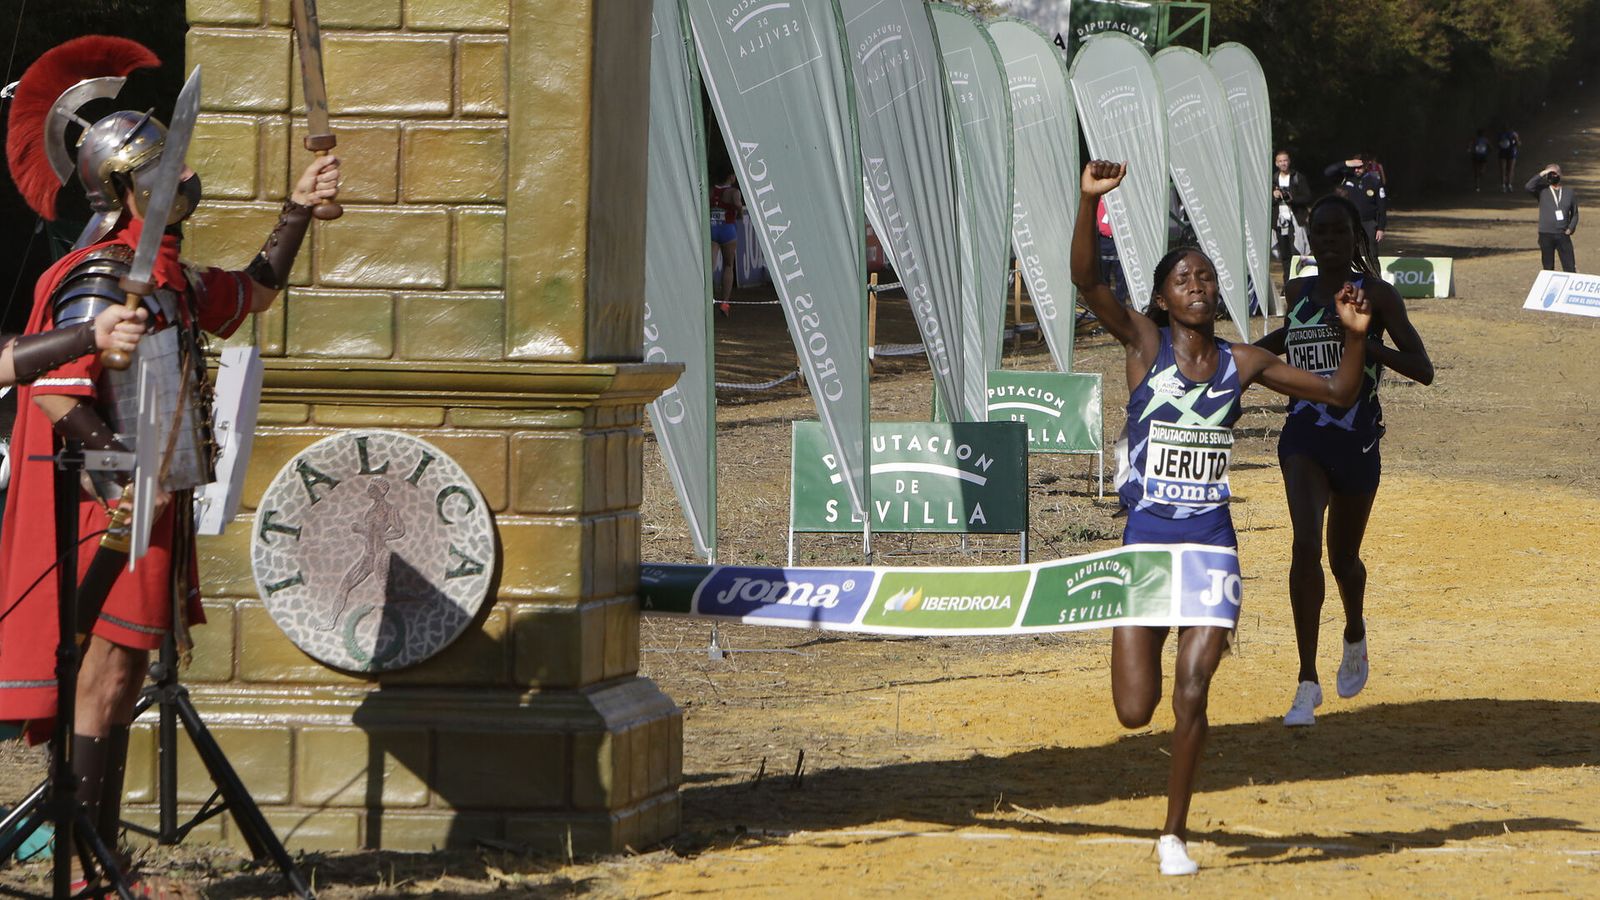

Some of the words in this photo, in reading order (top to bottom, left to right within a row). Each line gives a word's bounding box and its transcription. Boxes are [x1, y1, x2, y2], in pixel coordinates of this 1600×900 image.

[1076, 21, 1148, 42] DIPUTACION
[988, 386, 1065, 409] PUTACION
[1011, 414, 1025, 422] DE
[1151, 427, 1198, 443] DIPUTACION
[1200, 430, 1209, 444] DE
[1209, 431, 1234, 444] SEVILLA
[822, 435, 993, 472] DUTACION
[1154, 448, 1227, 481] JERUTO
[896, 480, 919, 494] DE
[1066, 560, 1132, 588] DIPUTACION
[921, 595, 1011, 612] IBERDROLA
[1090, 590, 1102, 600] DE
[1059, 601, 1123, 623] SEVILLA
